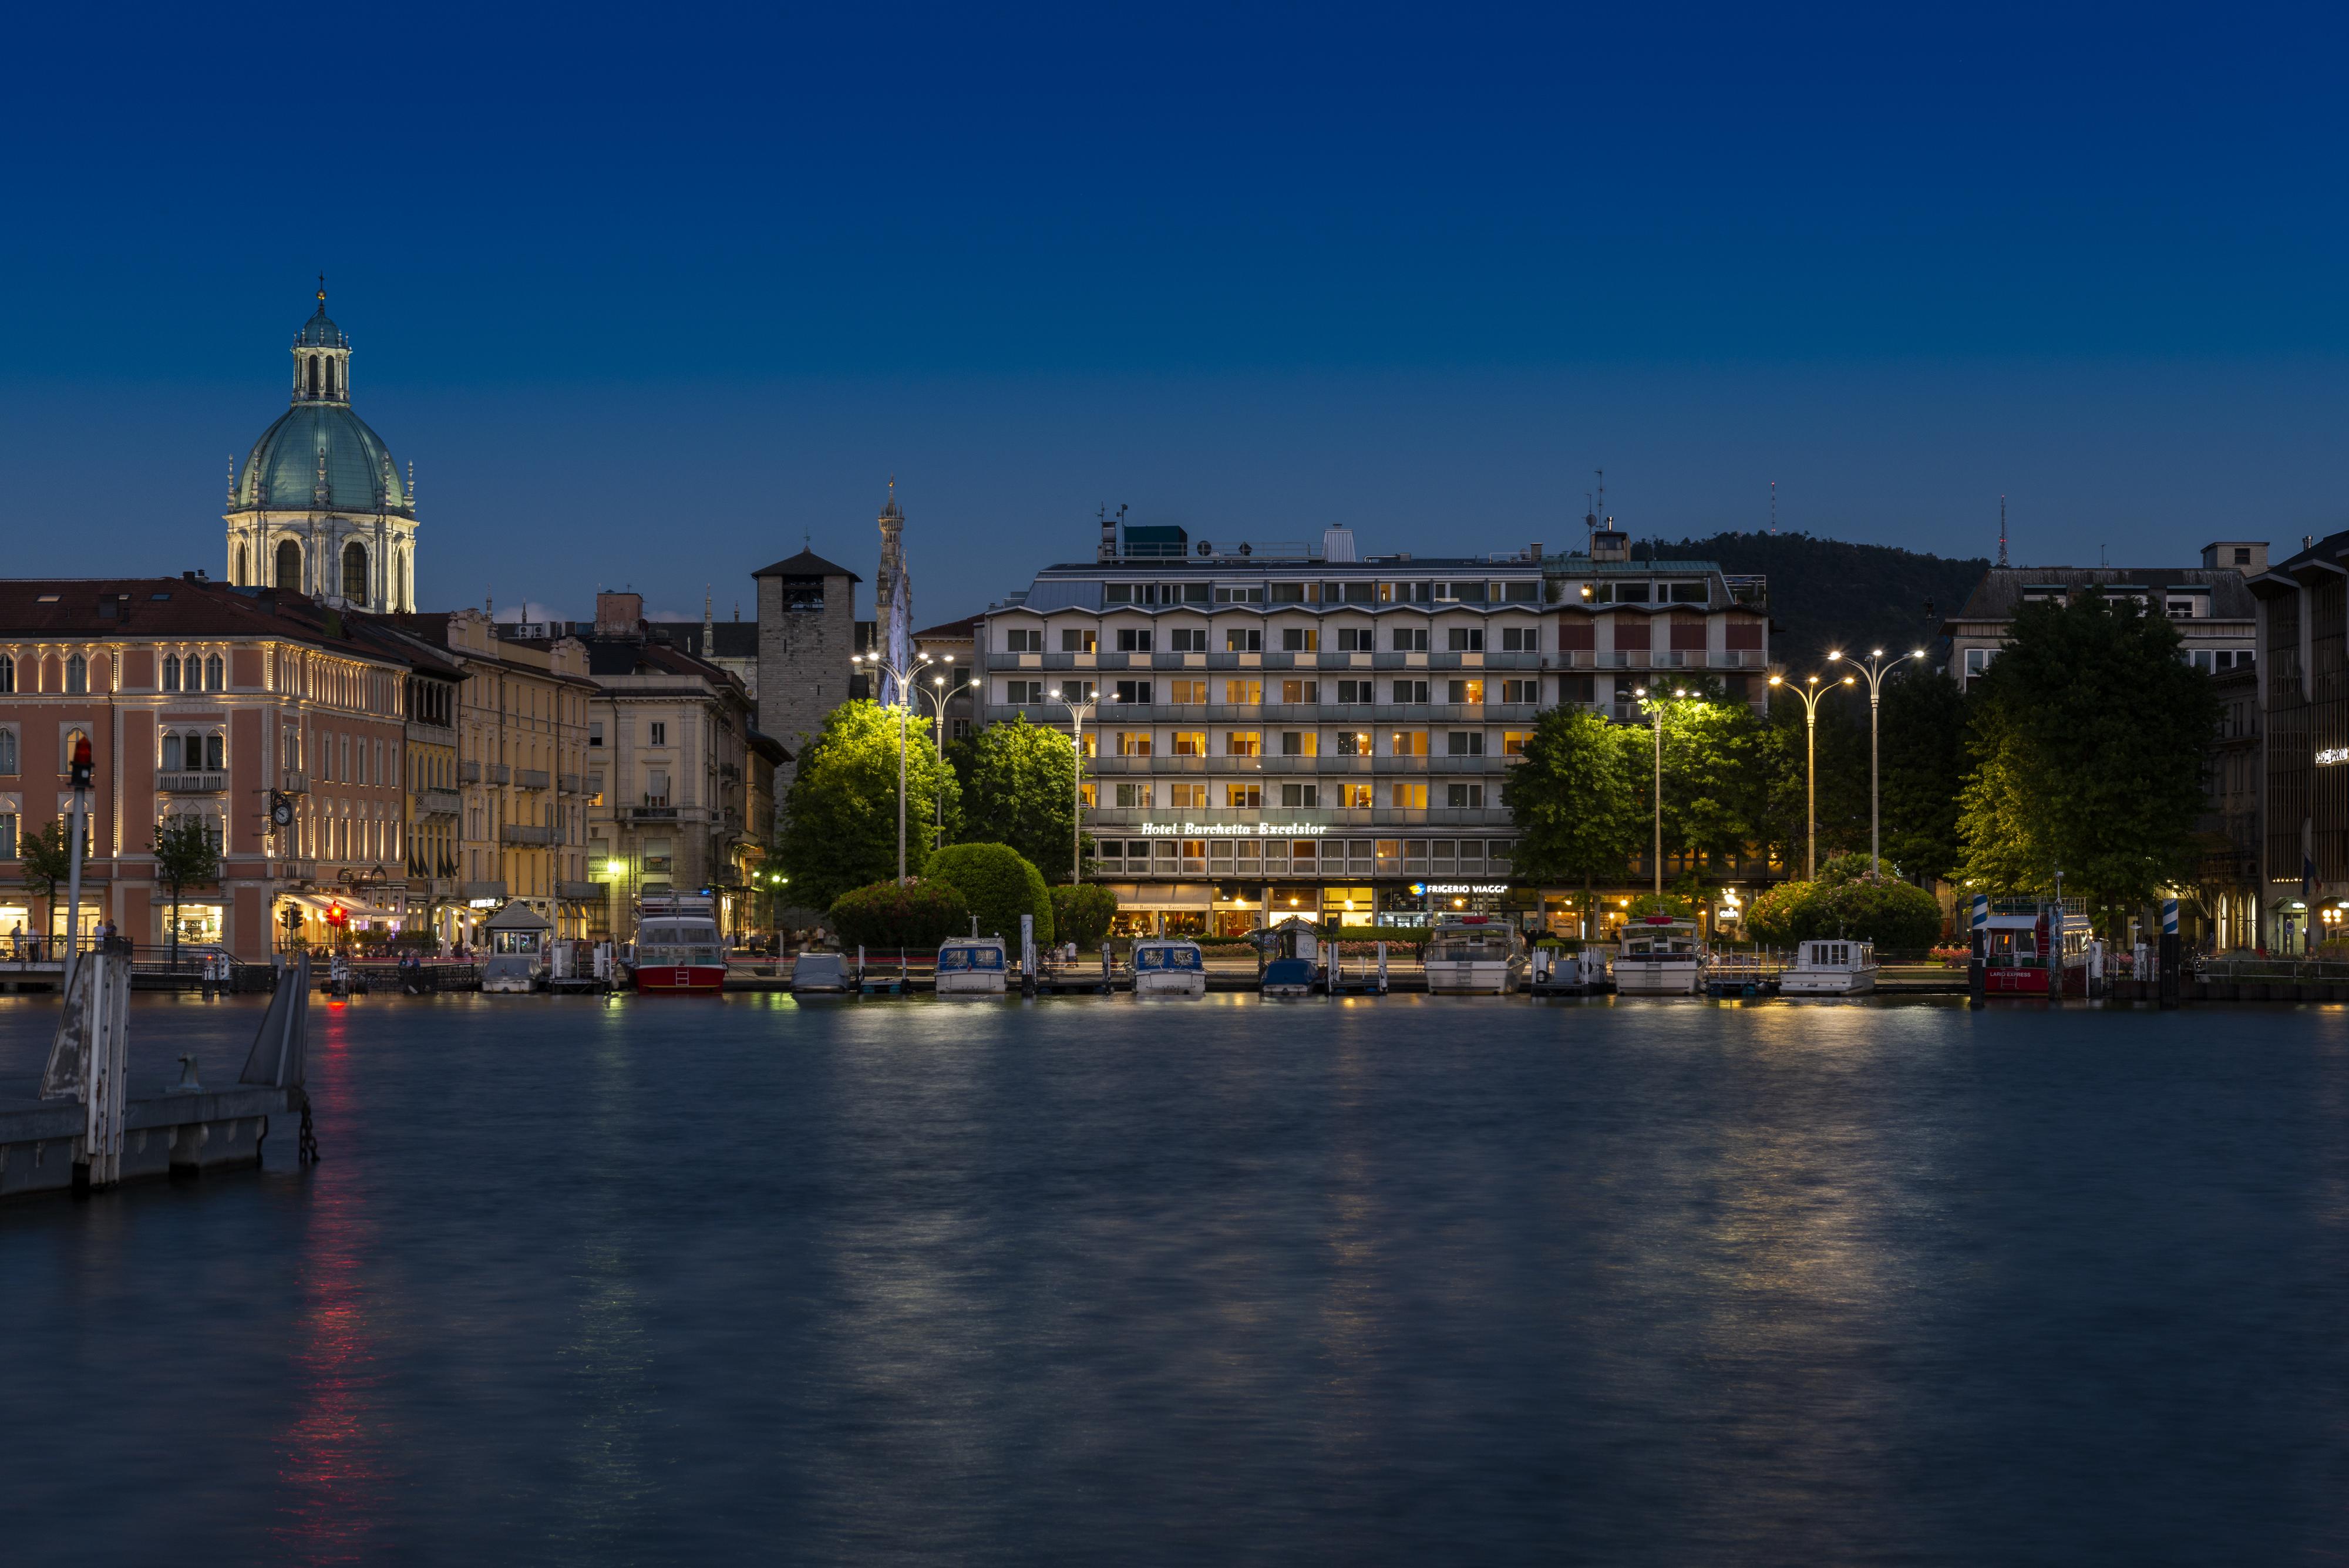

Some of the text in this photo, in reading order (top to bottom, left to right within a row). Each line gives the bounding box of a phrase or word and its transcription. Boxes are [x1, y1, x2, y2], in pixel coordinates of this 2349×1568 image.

[1141, 823, 1327, 835] Hotel Barchetta Excelsior
